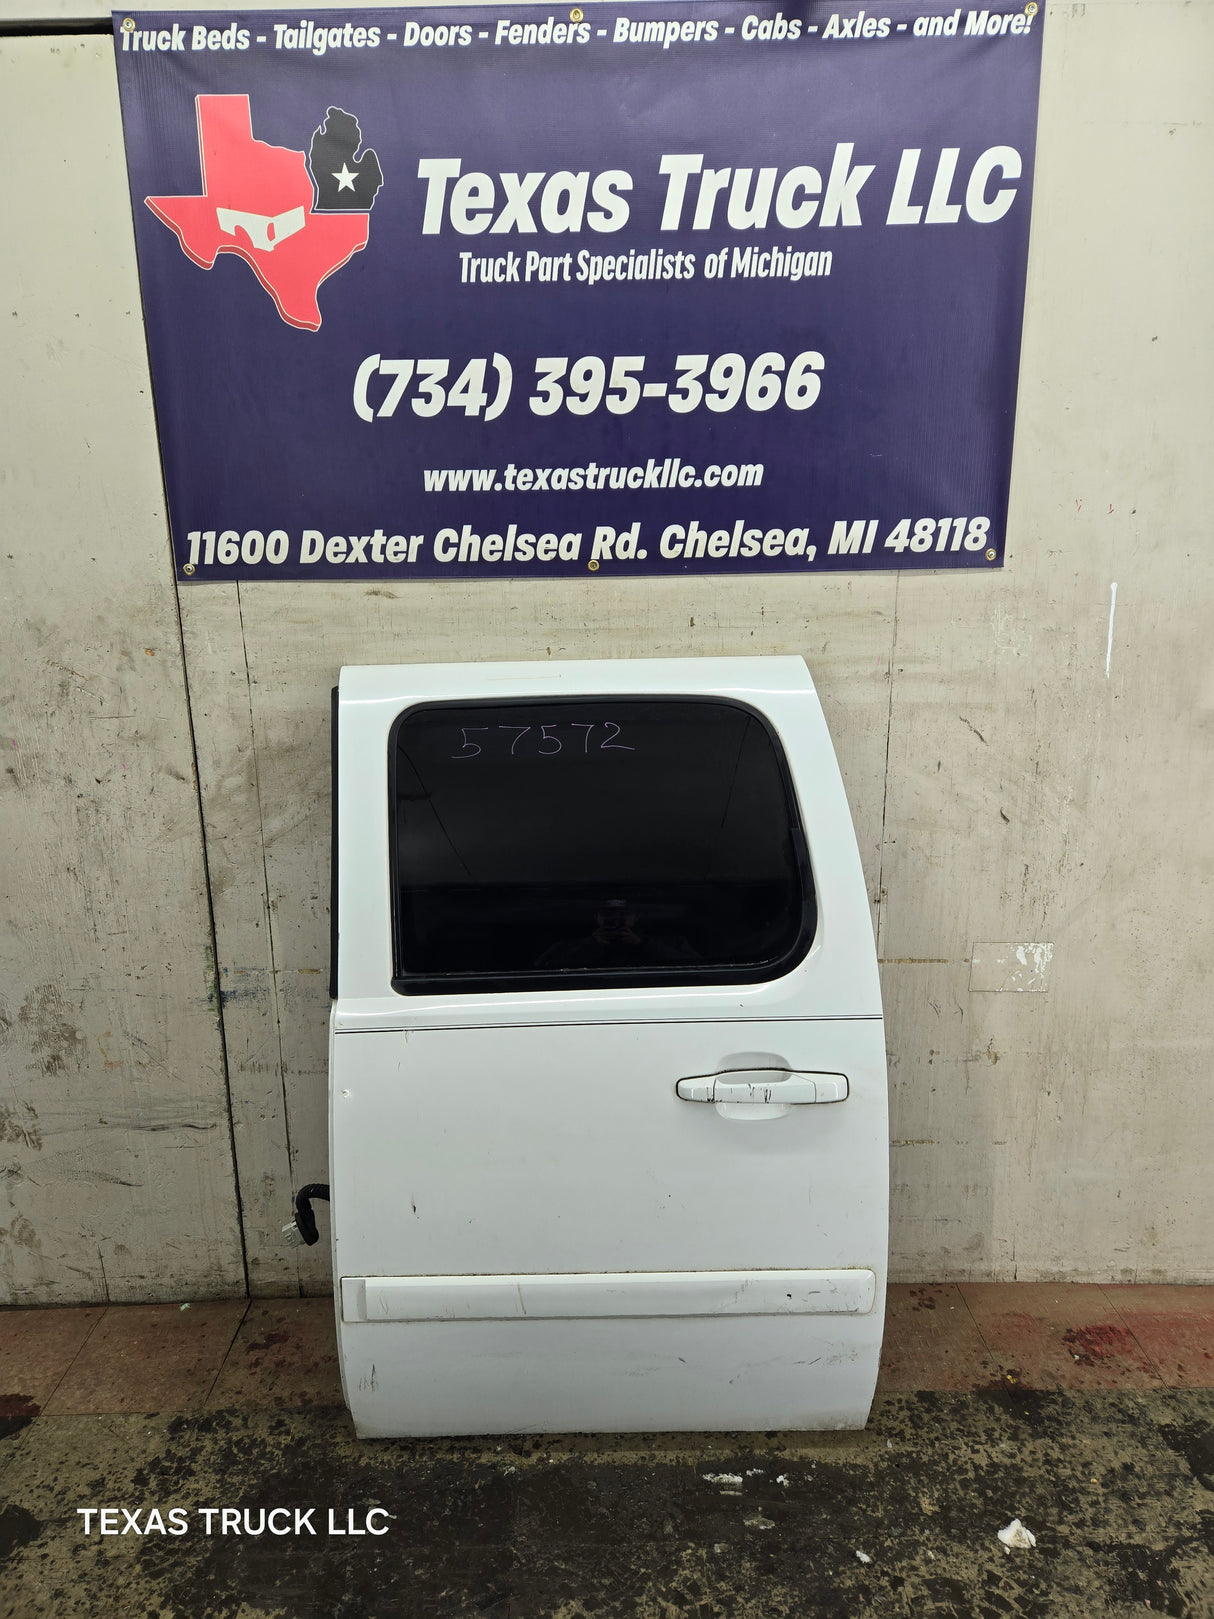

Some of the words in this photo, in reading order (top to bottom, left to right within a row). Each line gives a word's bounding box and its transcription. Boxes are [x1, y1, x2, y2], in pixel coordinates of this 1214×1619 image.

[119, 23, 187, 51] Truck
[191, 23, 250, 50] Beds
[273, 20, 381, 55] Tailgates
[403, 21, 473, 47] Doors
[495, 16, 591, 46] Fenders
[613, 17, 719, 49] Bumpers
[741, 12, 802, 41] Cabs
[822, 11, 891, 39] Axles
[913, 9, 960, 37] and
[963, 9, 1034, 36] More!
[417, 158, 634, 235] Texas
[658, 142, 876, 231] Truck
[885, 145, 1022, 226] LLC
[459, 251, 520, 283] Truck
[524, 252, 572, 282] Part
[576, 248, 696, 285] Specialists
[704, 247, 728, 279] of
[730, 246, 833, 281] Michigan
[353, 352, 513, 423] (734)
[528, 351, 826, 417] 395-3966
[423, 458, 764, 492] www.texastruckllc.com
[186, 529, 290, 565] 11600
[299, 528, 424, 564] Dexter
[432, 523, 583, 562] Chelsea
[590, 522, 648, 560] Rd.
[659, 520, 817, 562] Chelsea,
[827, 519, 879, 555] MI
[884, 516, 991, 553] 48118
[451, 721, 636, 759] 57572
